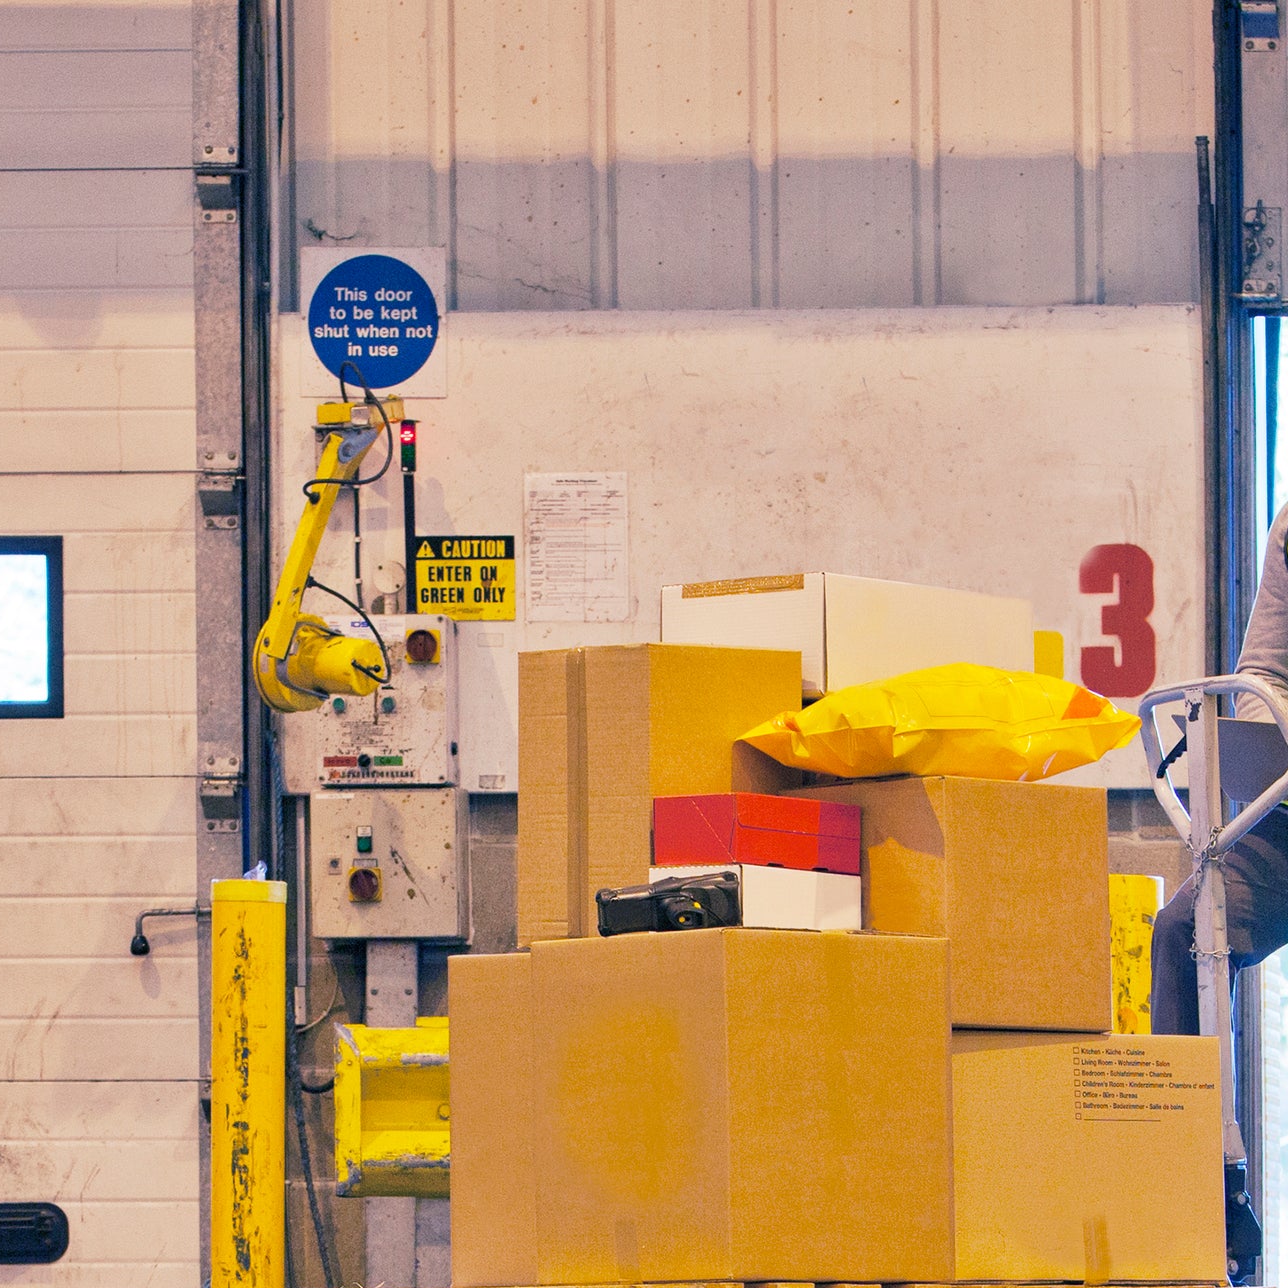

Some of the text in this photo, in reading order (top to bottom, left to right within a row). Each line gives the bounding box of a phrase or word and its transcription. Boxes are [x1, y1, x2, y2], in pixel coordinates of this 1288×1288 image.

[334, 286, 413, 302] This door
[329, 305, 418, 323] to be kept
[314, 323, 433, 338] shut when not
[347, 342, 399, 357] in use
[441, 540, 506, 558] CAUTION
[428, 566, 498, 582] ENTER ON
[420, 586, 506, 604] GREEN ONLY
[1079, 543, 1156, 698] 3
[1081, 1059, 1097, 1067] Living
